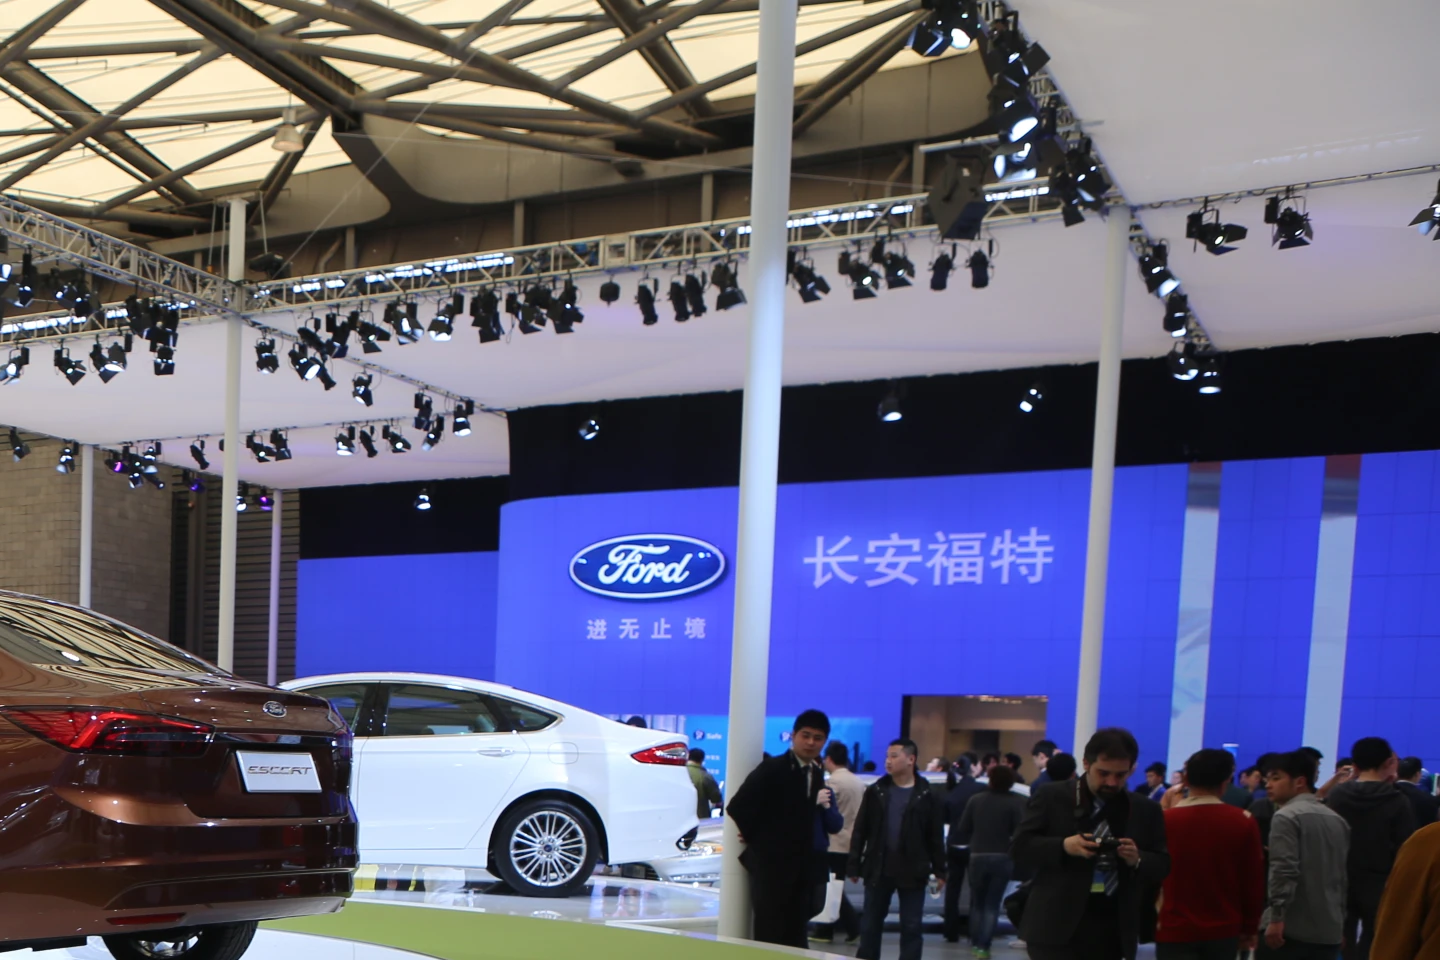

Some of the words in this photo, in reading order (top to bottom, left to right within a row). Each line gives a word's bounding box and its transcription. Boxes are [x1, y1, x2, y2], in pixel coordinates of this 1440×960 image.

[597, 543, 691, 586] Ford
[803, 527, 1054, 588] 长安福特
[586, 616, 707, 640] 进无止境
[248, 765, 313, 775] ESCORT
